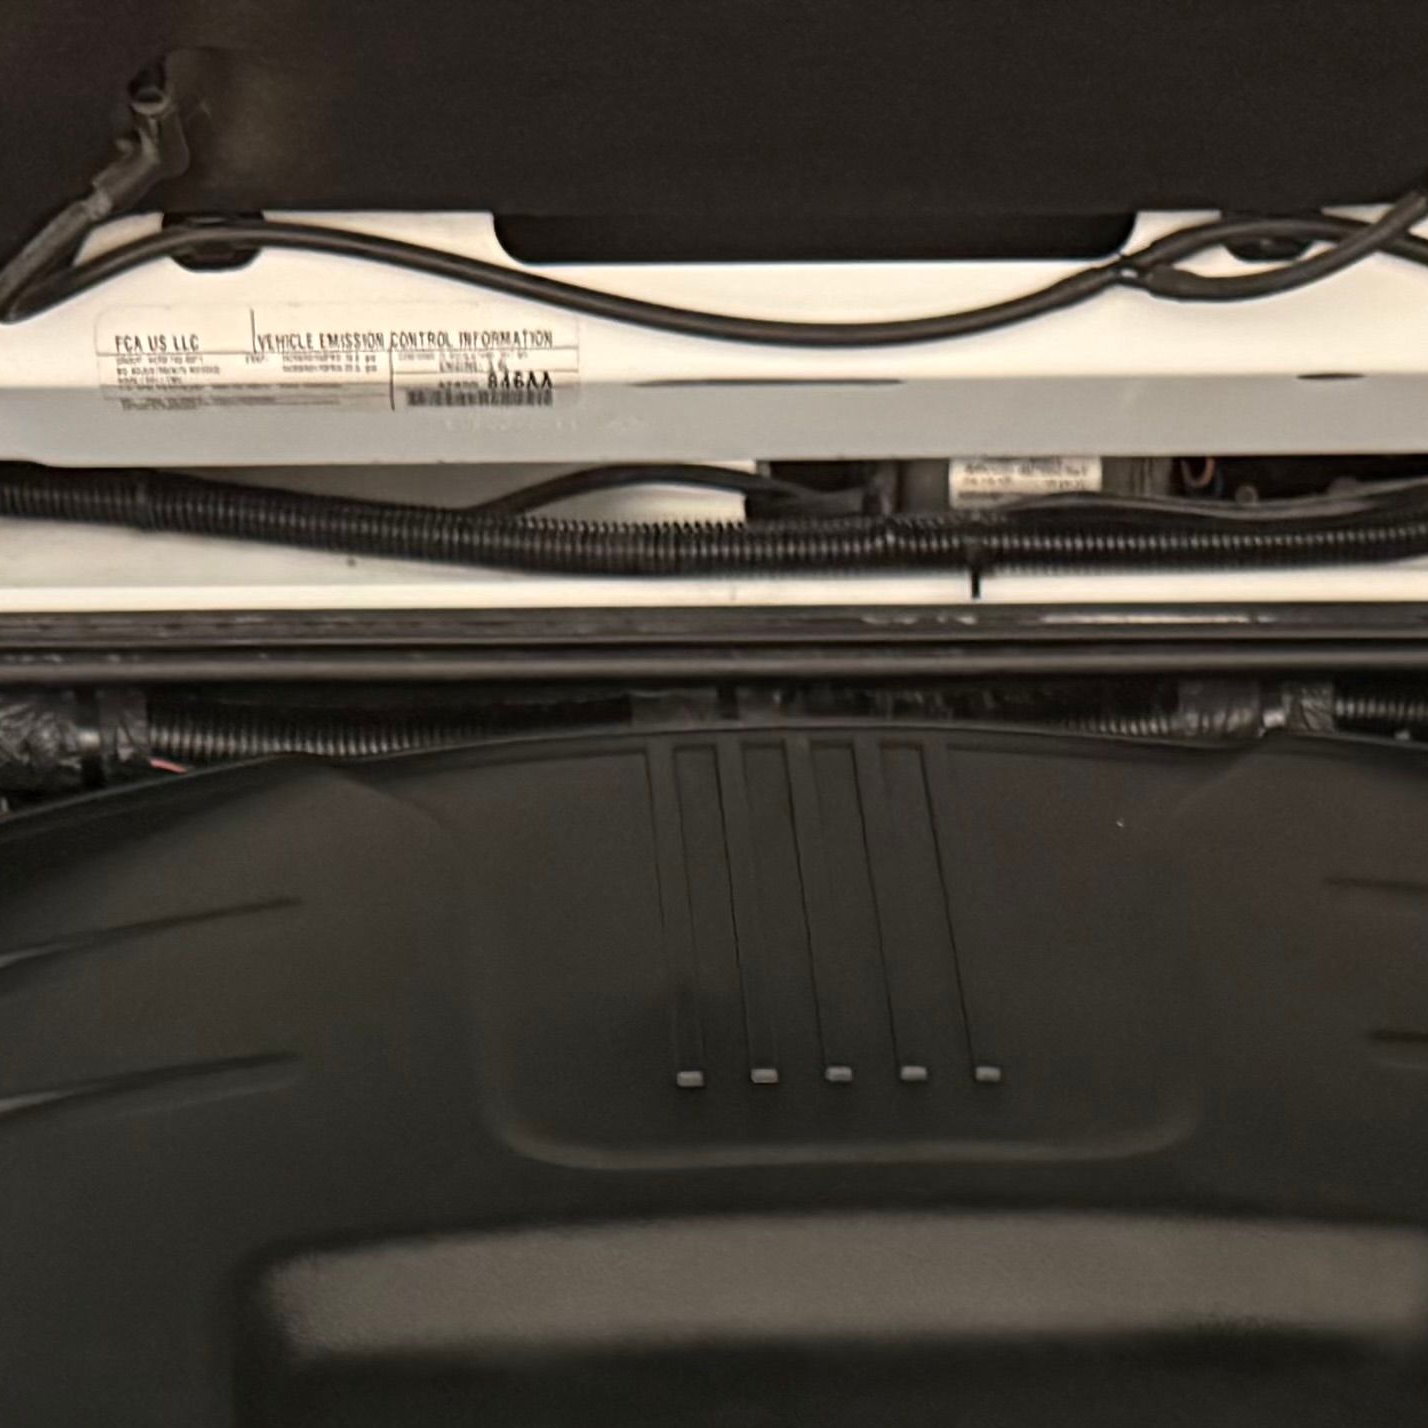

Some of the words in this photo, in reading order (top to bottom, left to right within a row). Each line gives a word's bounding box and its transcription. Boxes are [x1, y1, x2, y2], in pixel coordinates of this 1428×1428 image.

[115, 334, 142, 352] FCA
[147, 334, 167, 351] US
[173, 333, 199, 350] LLC
[258, 333, 313, 350] VEHICLE
[319, 332, 384, 349] EMISSION
[390, 331, 451, 349] CONTROL
[458, 329, 553, 348] INFORMATION
